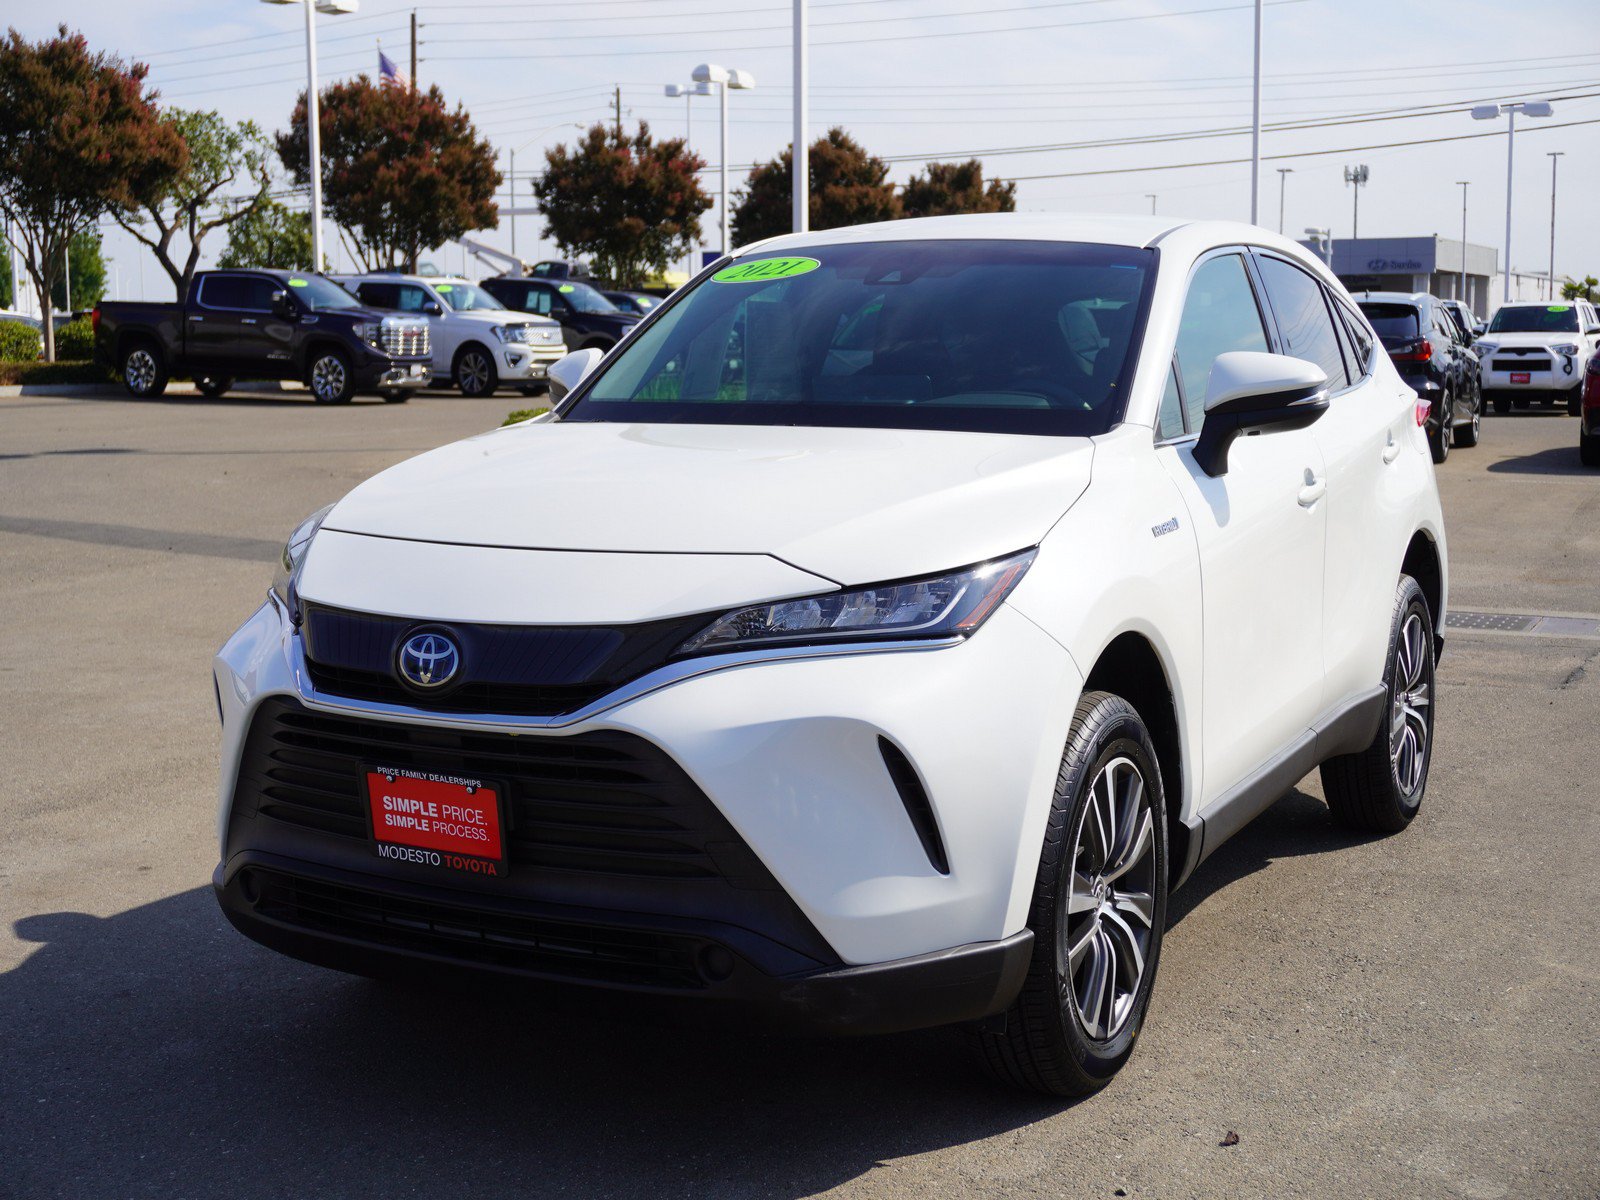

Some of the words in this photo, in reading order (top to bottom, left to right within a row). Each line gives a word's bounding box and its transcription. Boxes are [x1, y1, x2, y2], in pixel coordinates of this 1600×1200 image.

[723, 260, 806, 279] 2021
[377, 766, 400, 777] PRICE
[401, 769, 427, 780] FAMILY
[429, 774, 482, 788] DEALERSHIPS
[383, 795, 438, 817] SIMPLE
[442, 804, 488, 826] PRICE.
[385, 814, 429, 831] SIMPLE
[433, 821, 490, 841] PROCESS.
[378, 844, 440, 865] MODESTO
[444, 855, 497, 875] TOYOTA
